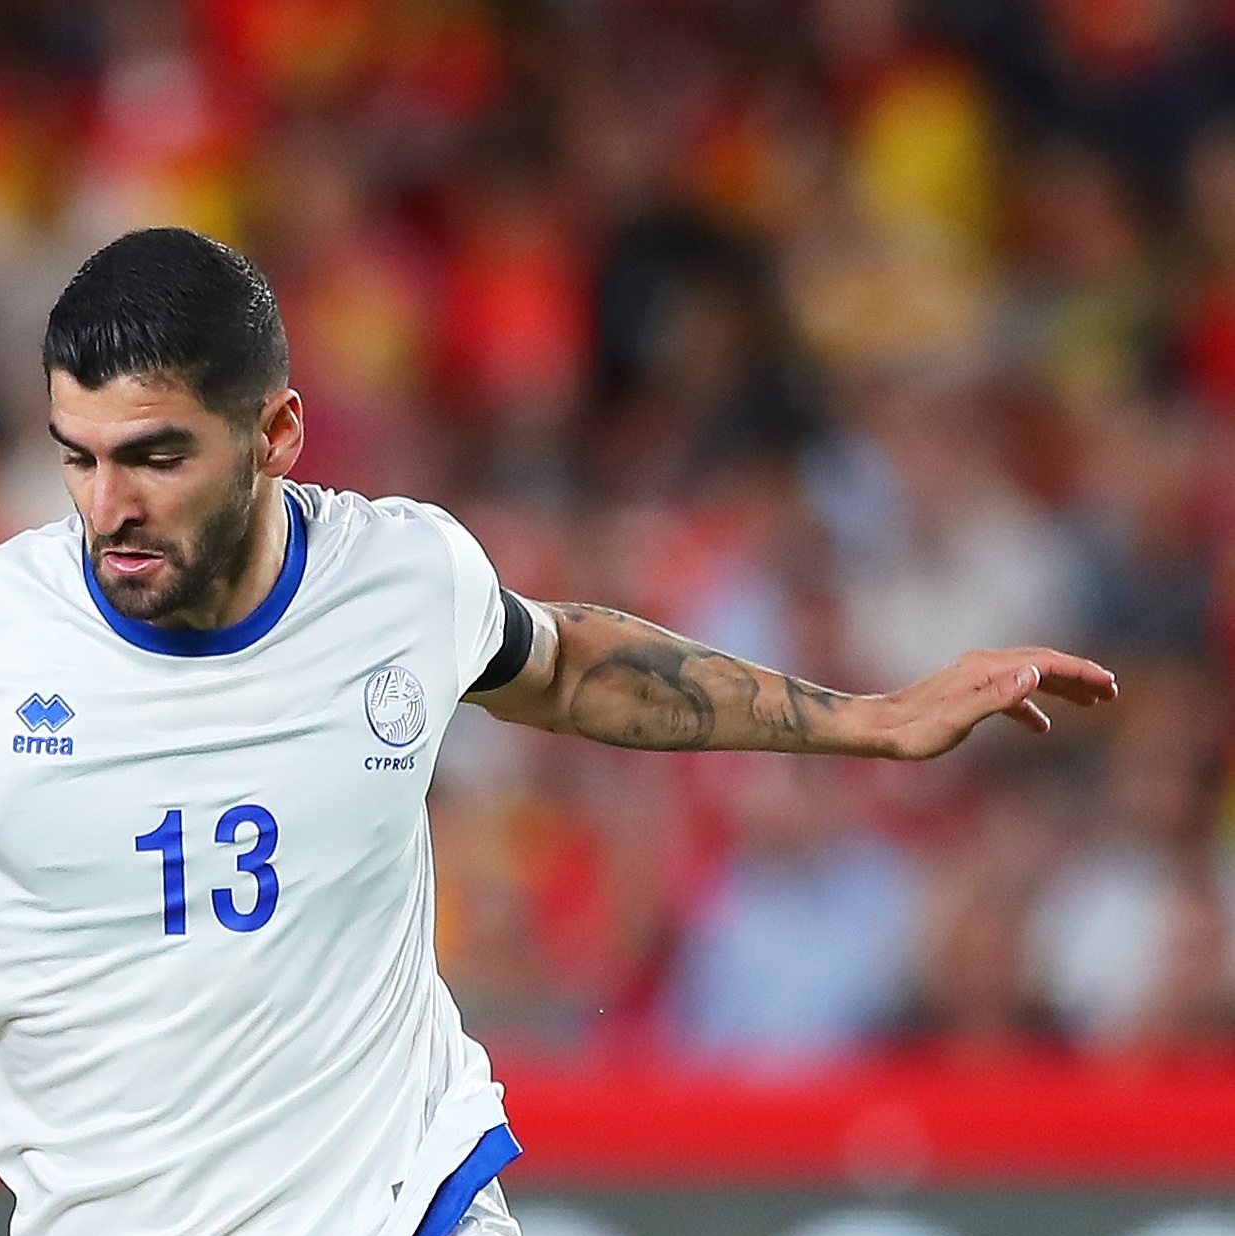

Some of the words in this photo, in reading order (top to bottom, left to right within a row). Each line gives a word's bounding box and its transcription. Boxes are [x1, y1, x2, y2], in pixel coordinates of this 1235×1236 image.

[12, 734, 74, 756] errea
[364, 756, 415, 771] CYPRUS
[135, 804, 280, 935] 13
